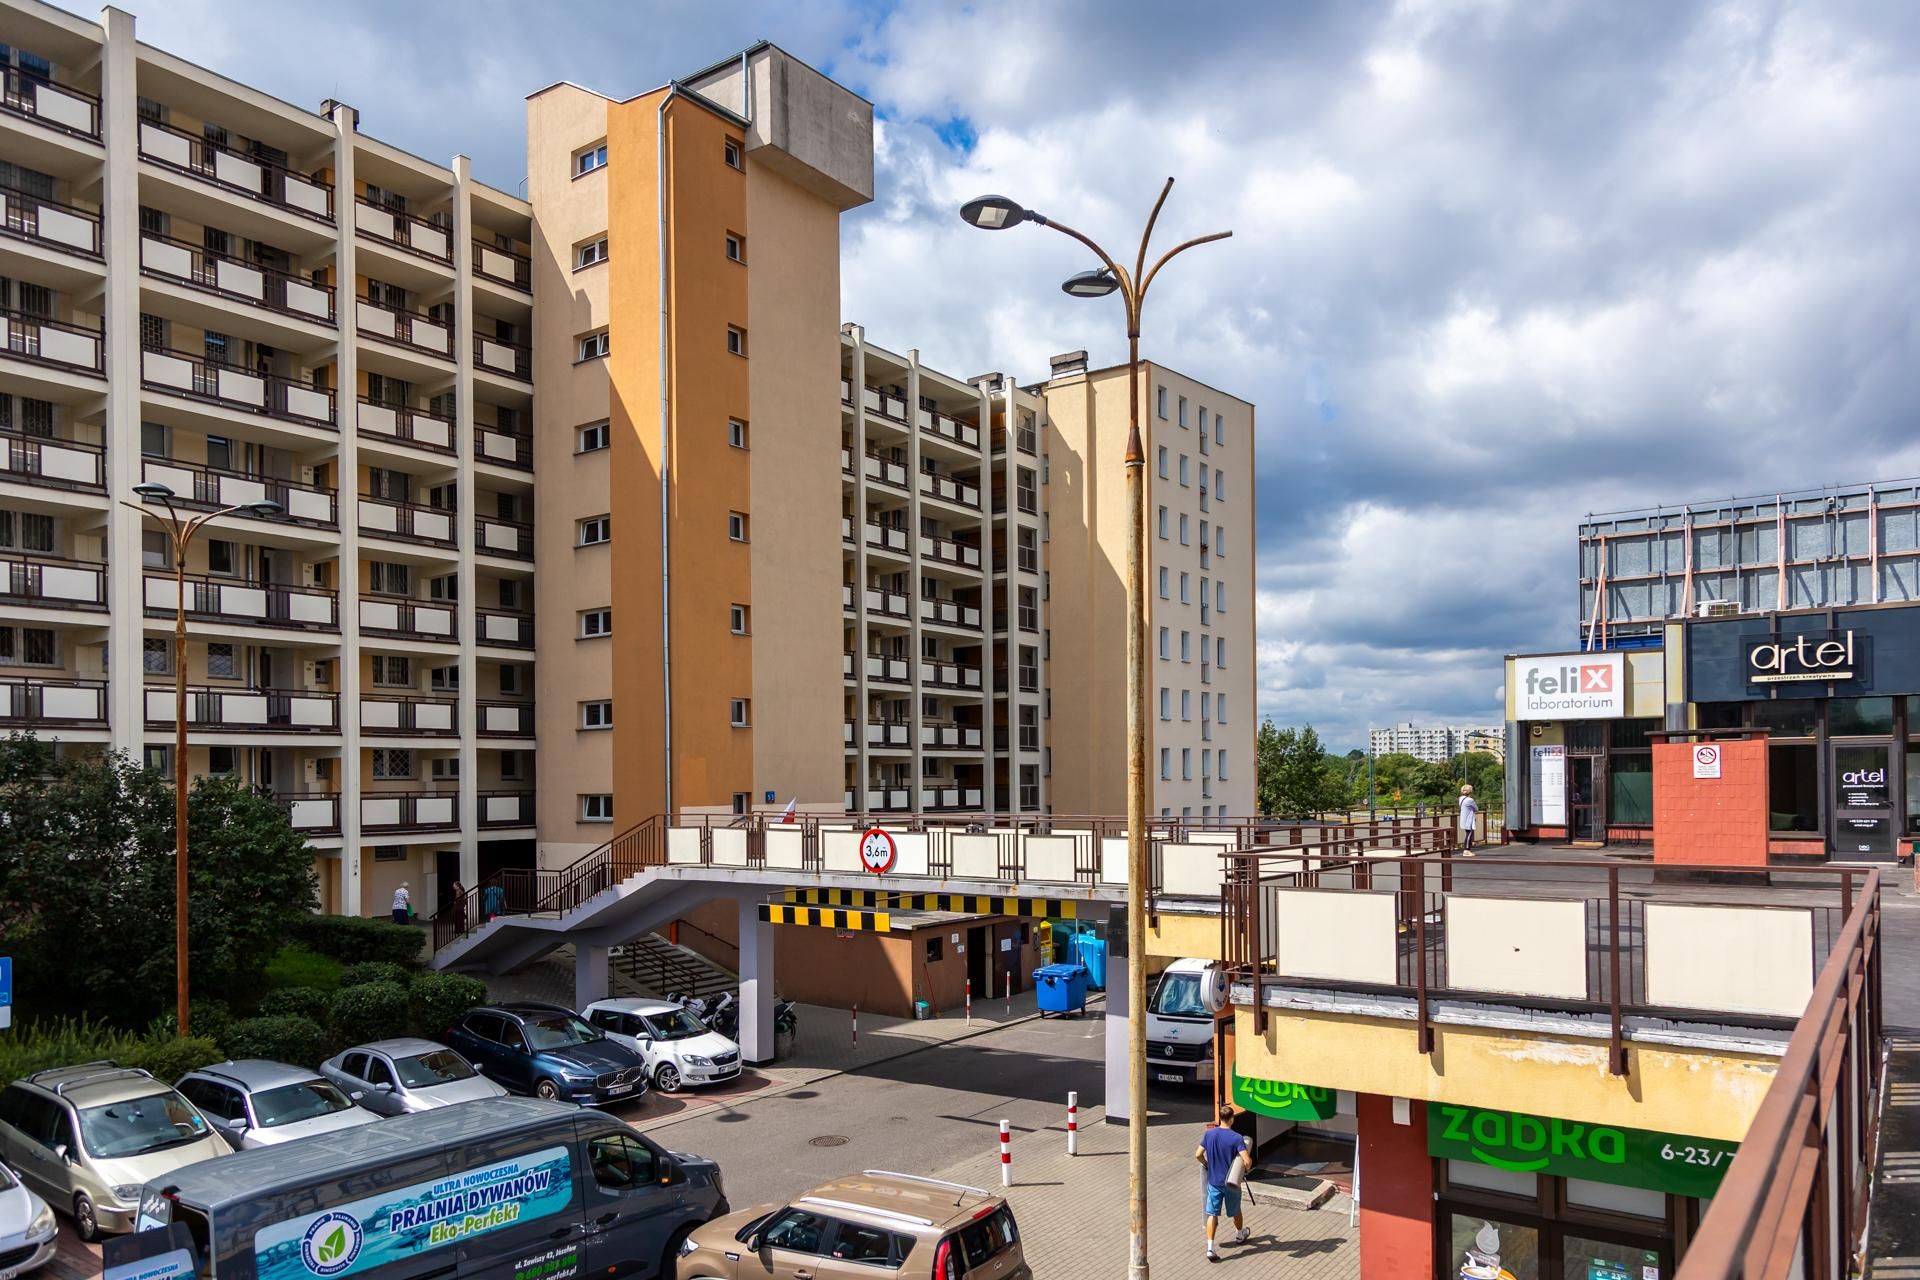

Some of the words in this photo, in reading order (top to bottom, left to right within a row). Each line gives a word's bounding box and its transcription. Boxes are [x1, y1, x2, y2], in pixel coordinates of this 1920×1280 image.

[1751, 631, 1853, 673] artel
[1527, 696, 1613, 710] laboratorium
[1842, 768, 1884, 784] artel
[433, 1177, 462, 1195] ULTRA
[463, 1163, 520, 1187] NOWOCZESNA
[391, 1195, 464, 1232] PRALNIA
[468, 1169, 550, 1211] DYWANÓW
[431, 1204, 519, 1245] Eko-Perfekt
